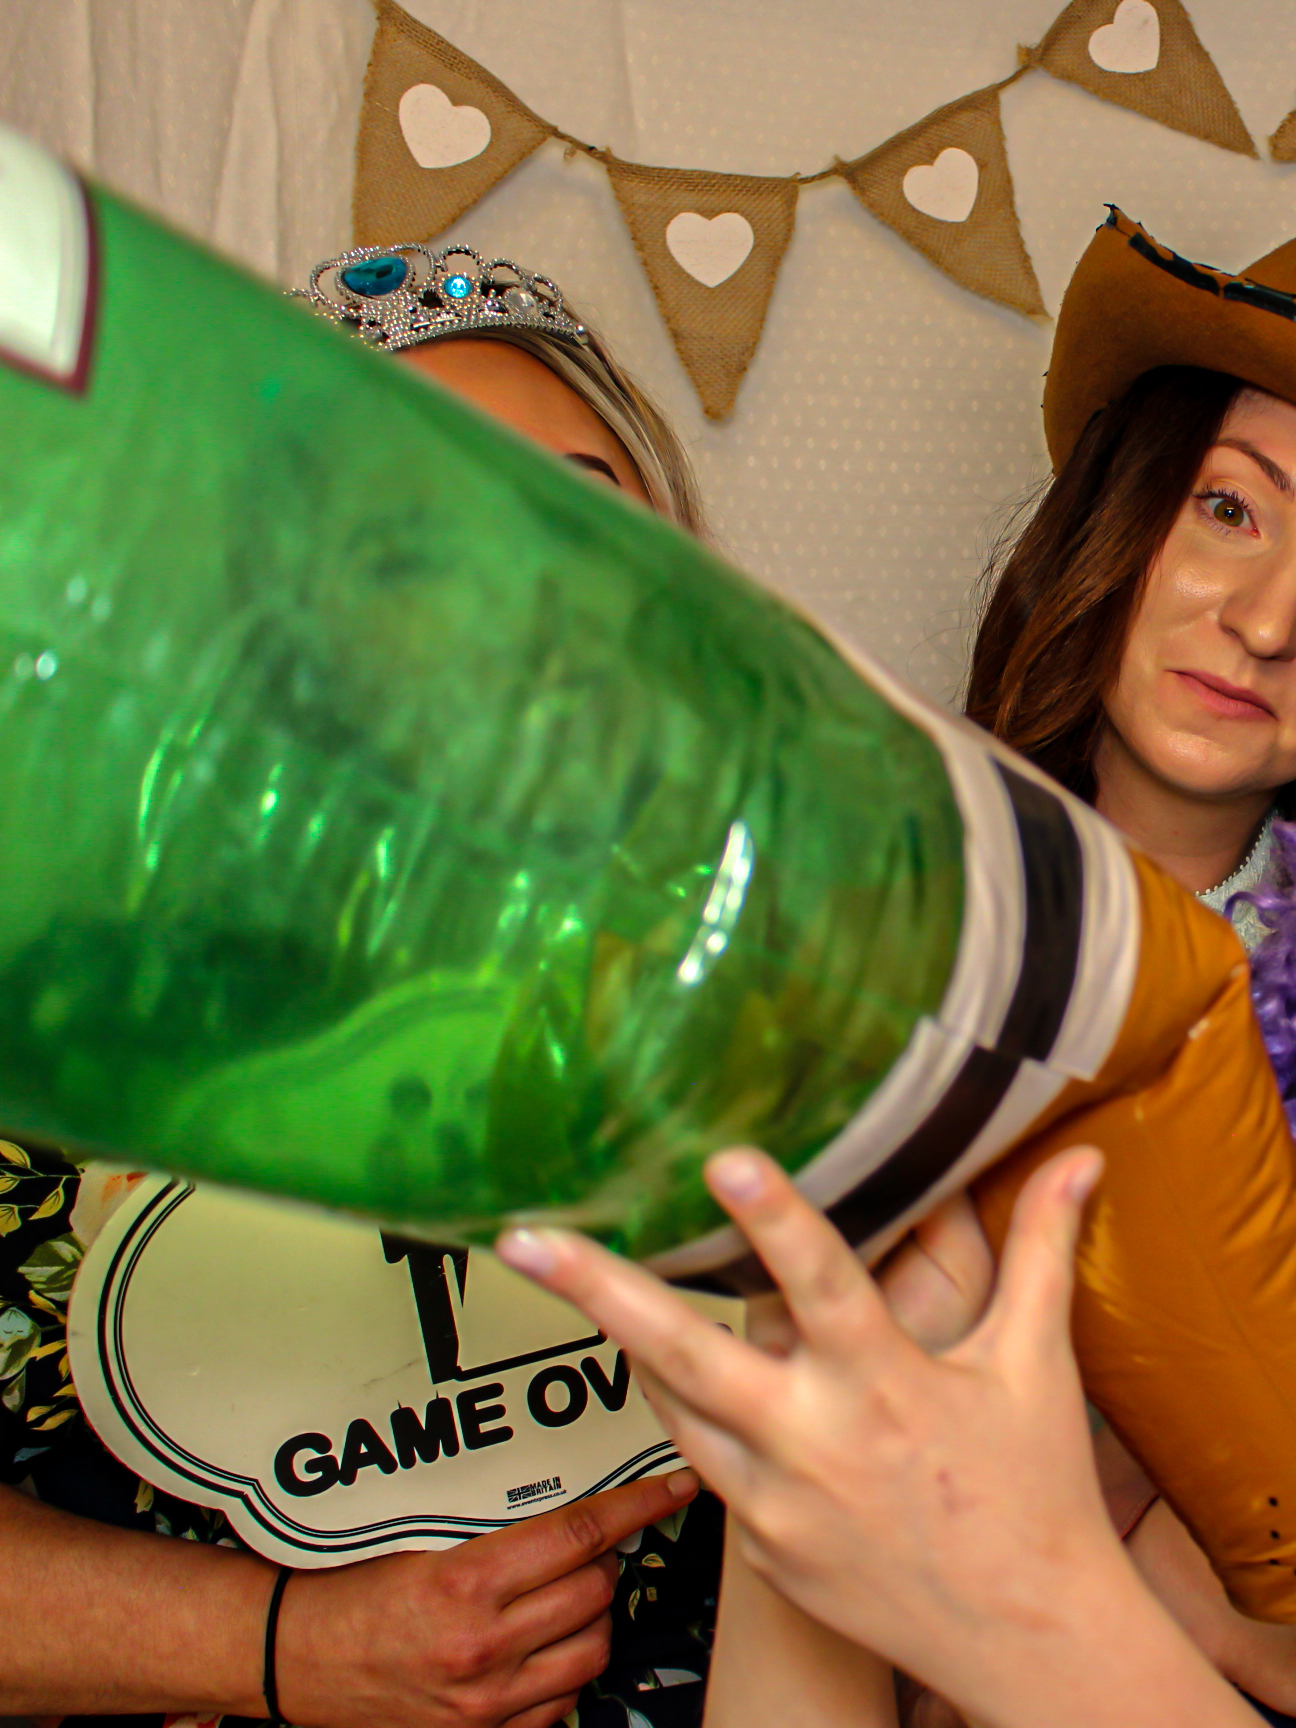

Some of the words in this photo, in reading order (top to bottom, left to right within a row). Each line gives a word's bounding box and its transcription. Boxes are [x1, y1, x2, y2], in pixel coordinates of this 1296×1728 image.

[273, 1382, 514, 1498] GAME
[530, 1478, 551, 1490] MADE
[552, 1475, 561, 1485] IN
[531, 1482, 562, 1497] BRITAIN
